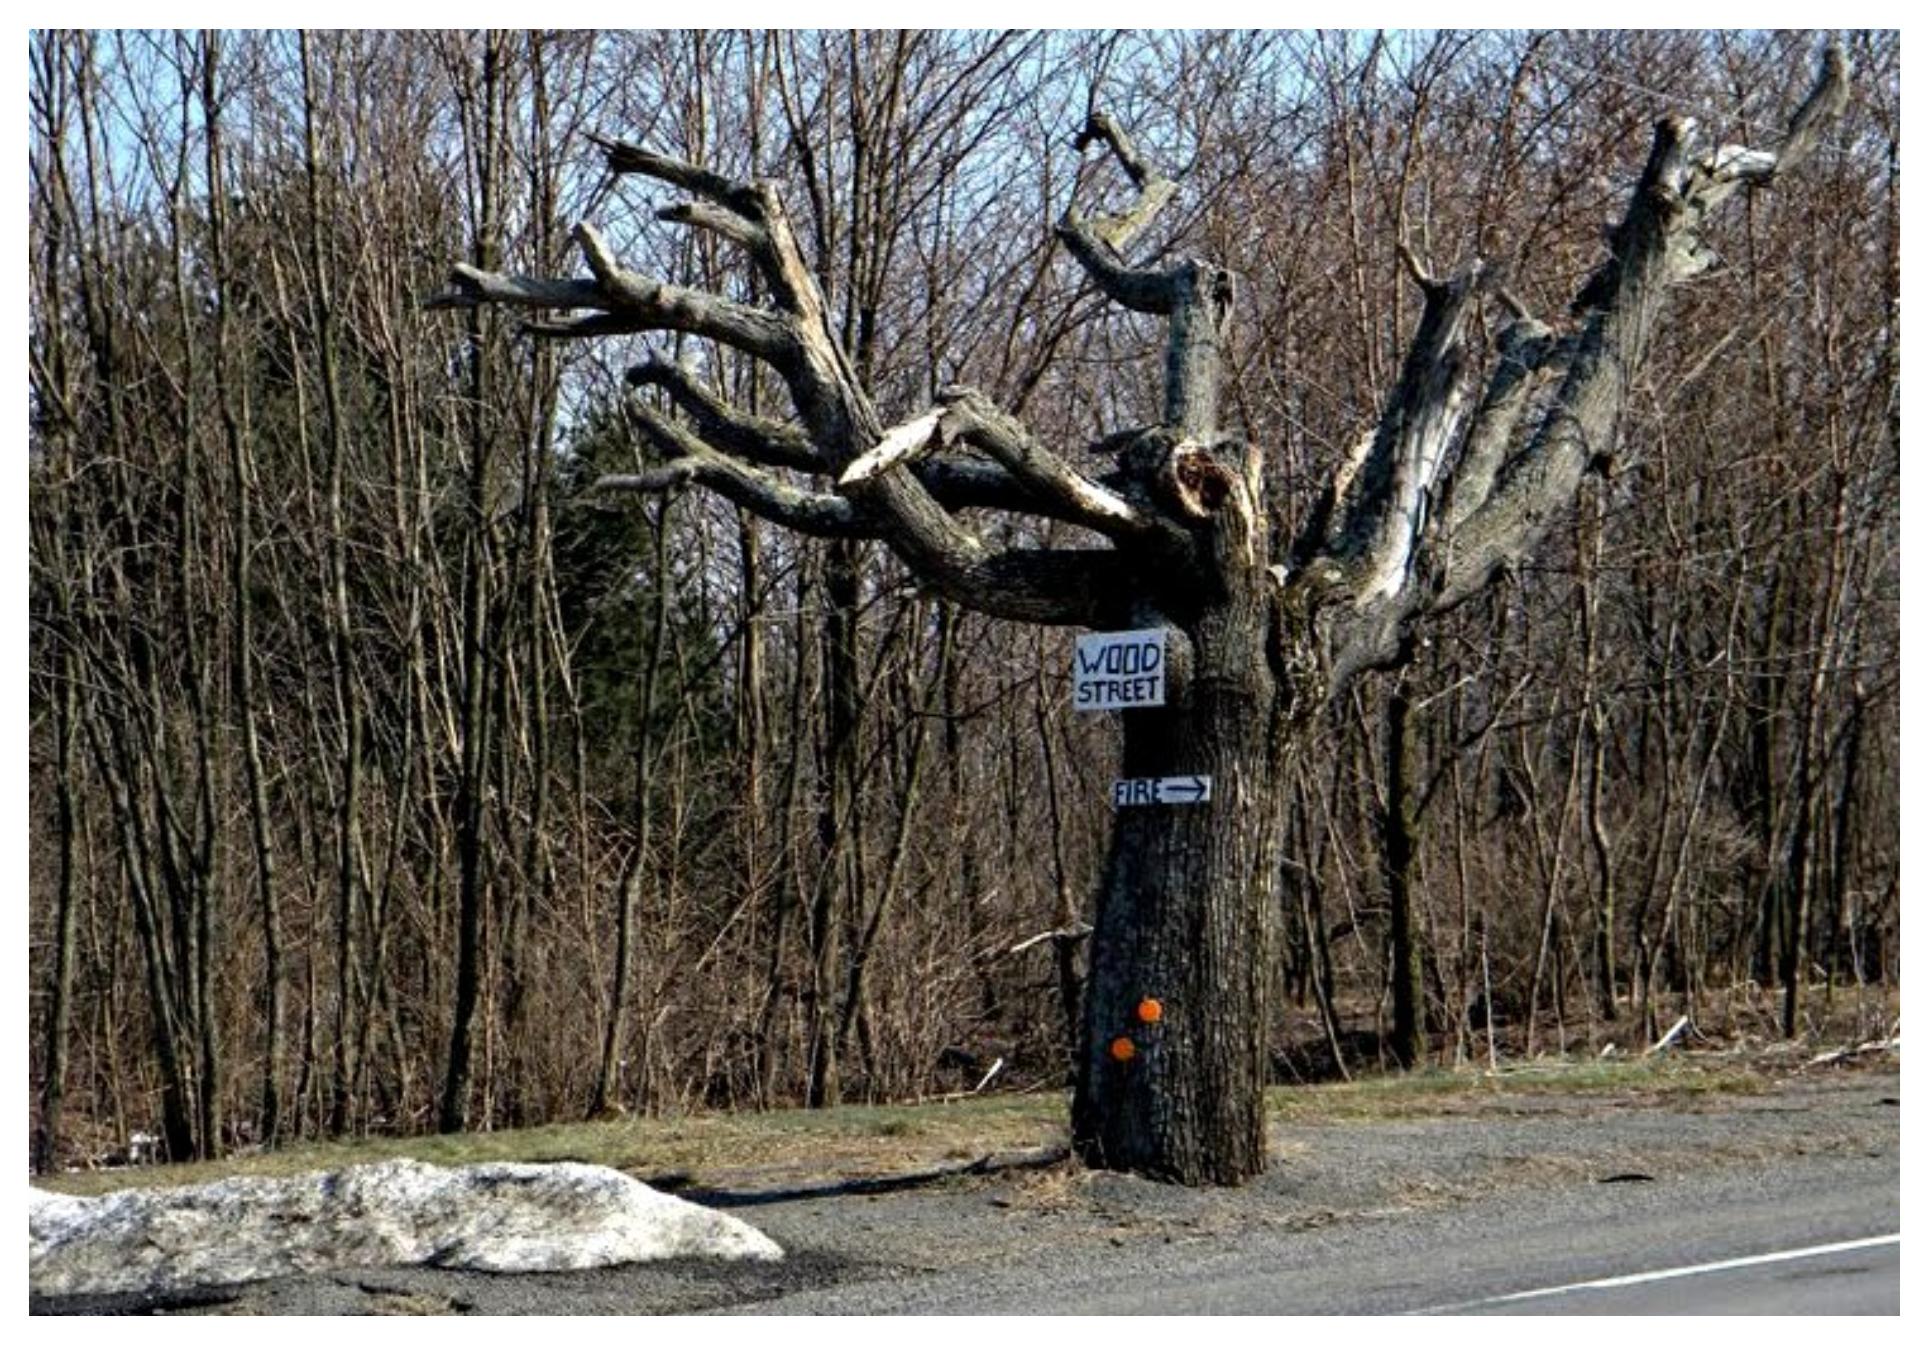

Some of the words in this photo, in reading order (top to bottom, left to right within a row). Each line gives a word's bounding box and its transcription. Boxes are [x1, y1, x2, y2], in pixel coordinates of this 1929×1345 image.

[1078, 643, 1160, 674] WOOD
[1078, 676, 1159, 702] STREET
[1116, 779, 1162, 804] FIRE
